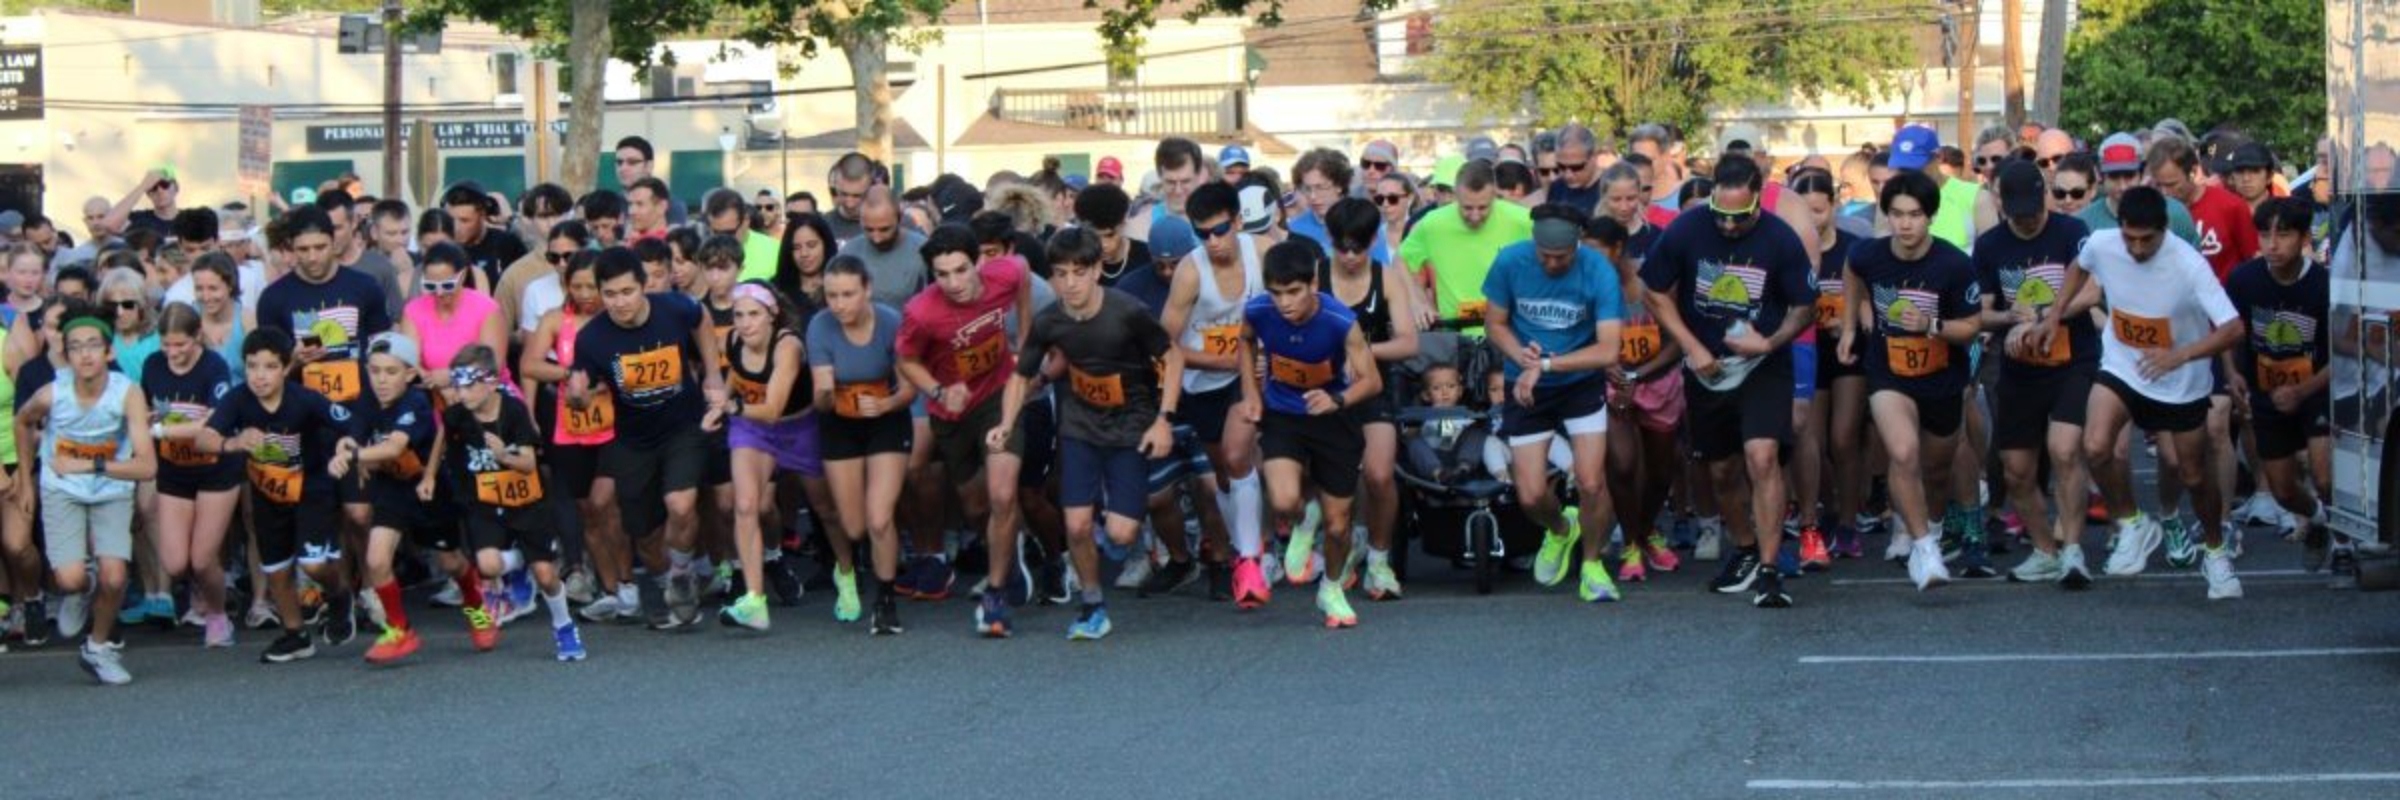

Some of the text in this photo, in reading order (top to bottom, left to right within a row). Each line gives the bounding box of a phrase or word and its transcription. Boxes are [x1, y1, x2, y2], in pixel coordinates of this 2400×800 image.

[6, 54, 37, 68] LAW
[324, 127, 384, 139] PERSONA
[438, 124, 463, 136] LAW
[474, 123, 511, 135] TRIAL
[1519, 302, 1586, 319] HAMMER
[1905, 350, 1929, 369] 87
[635, 359, 671, 385] 272
[1295, 370, 1307, 384] 3
[320, 373, 344, 394] 54
[570, 405, 603, 428] 514
[256, 471, 289, 497] 144
[494, 479, 530, 504] 148
